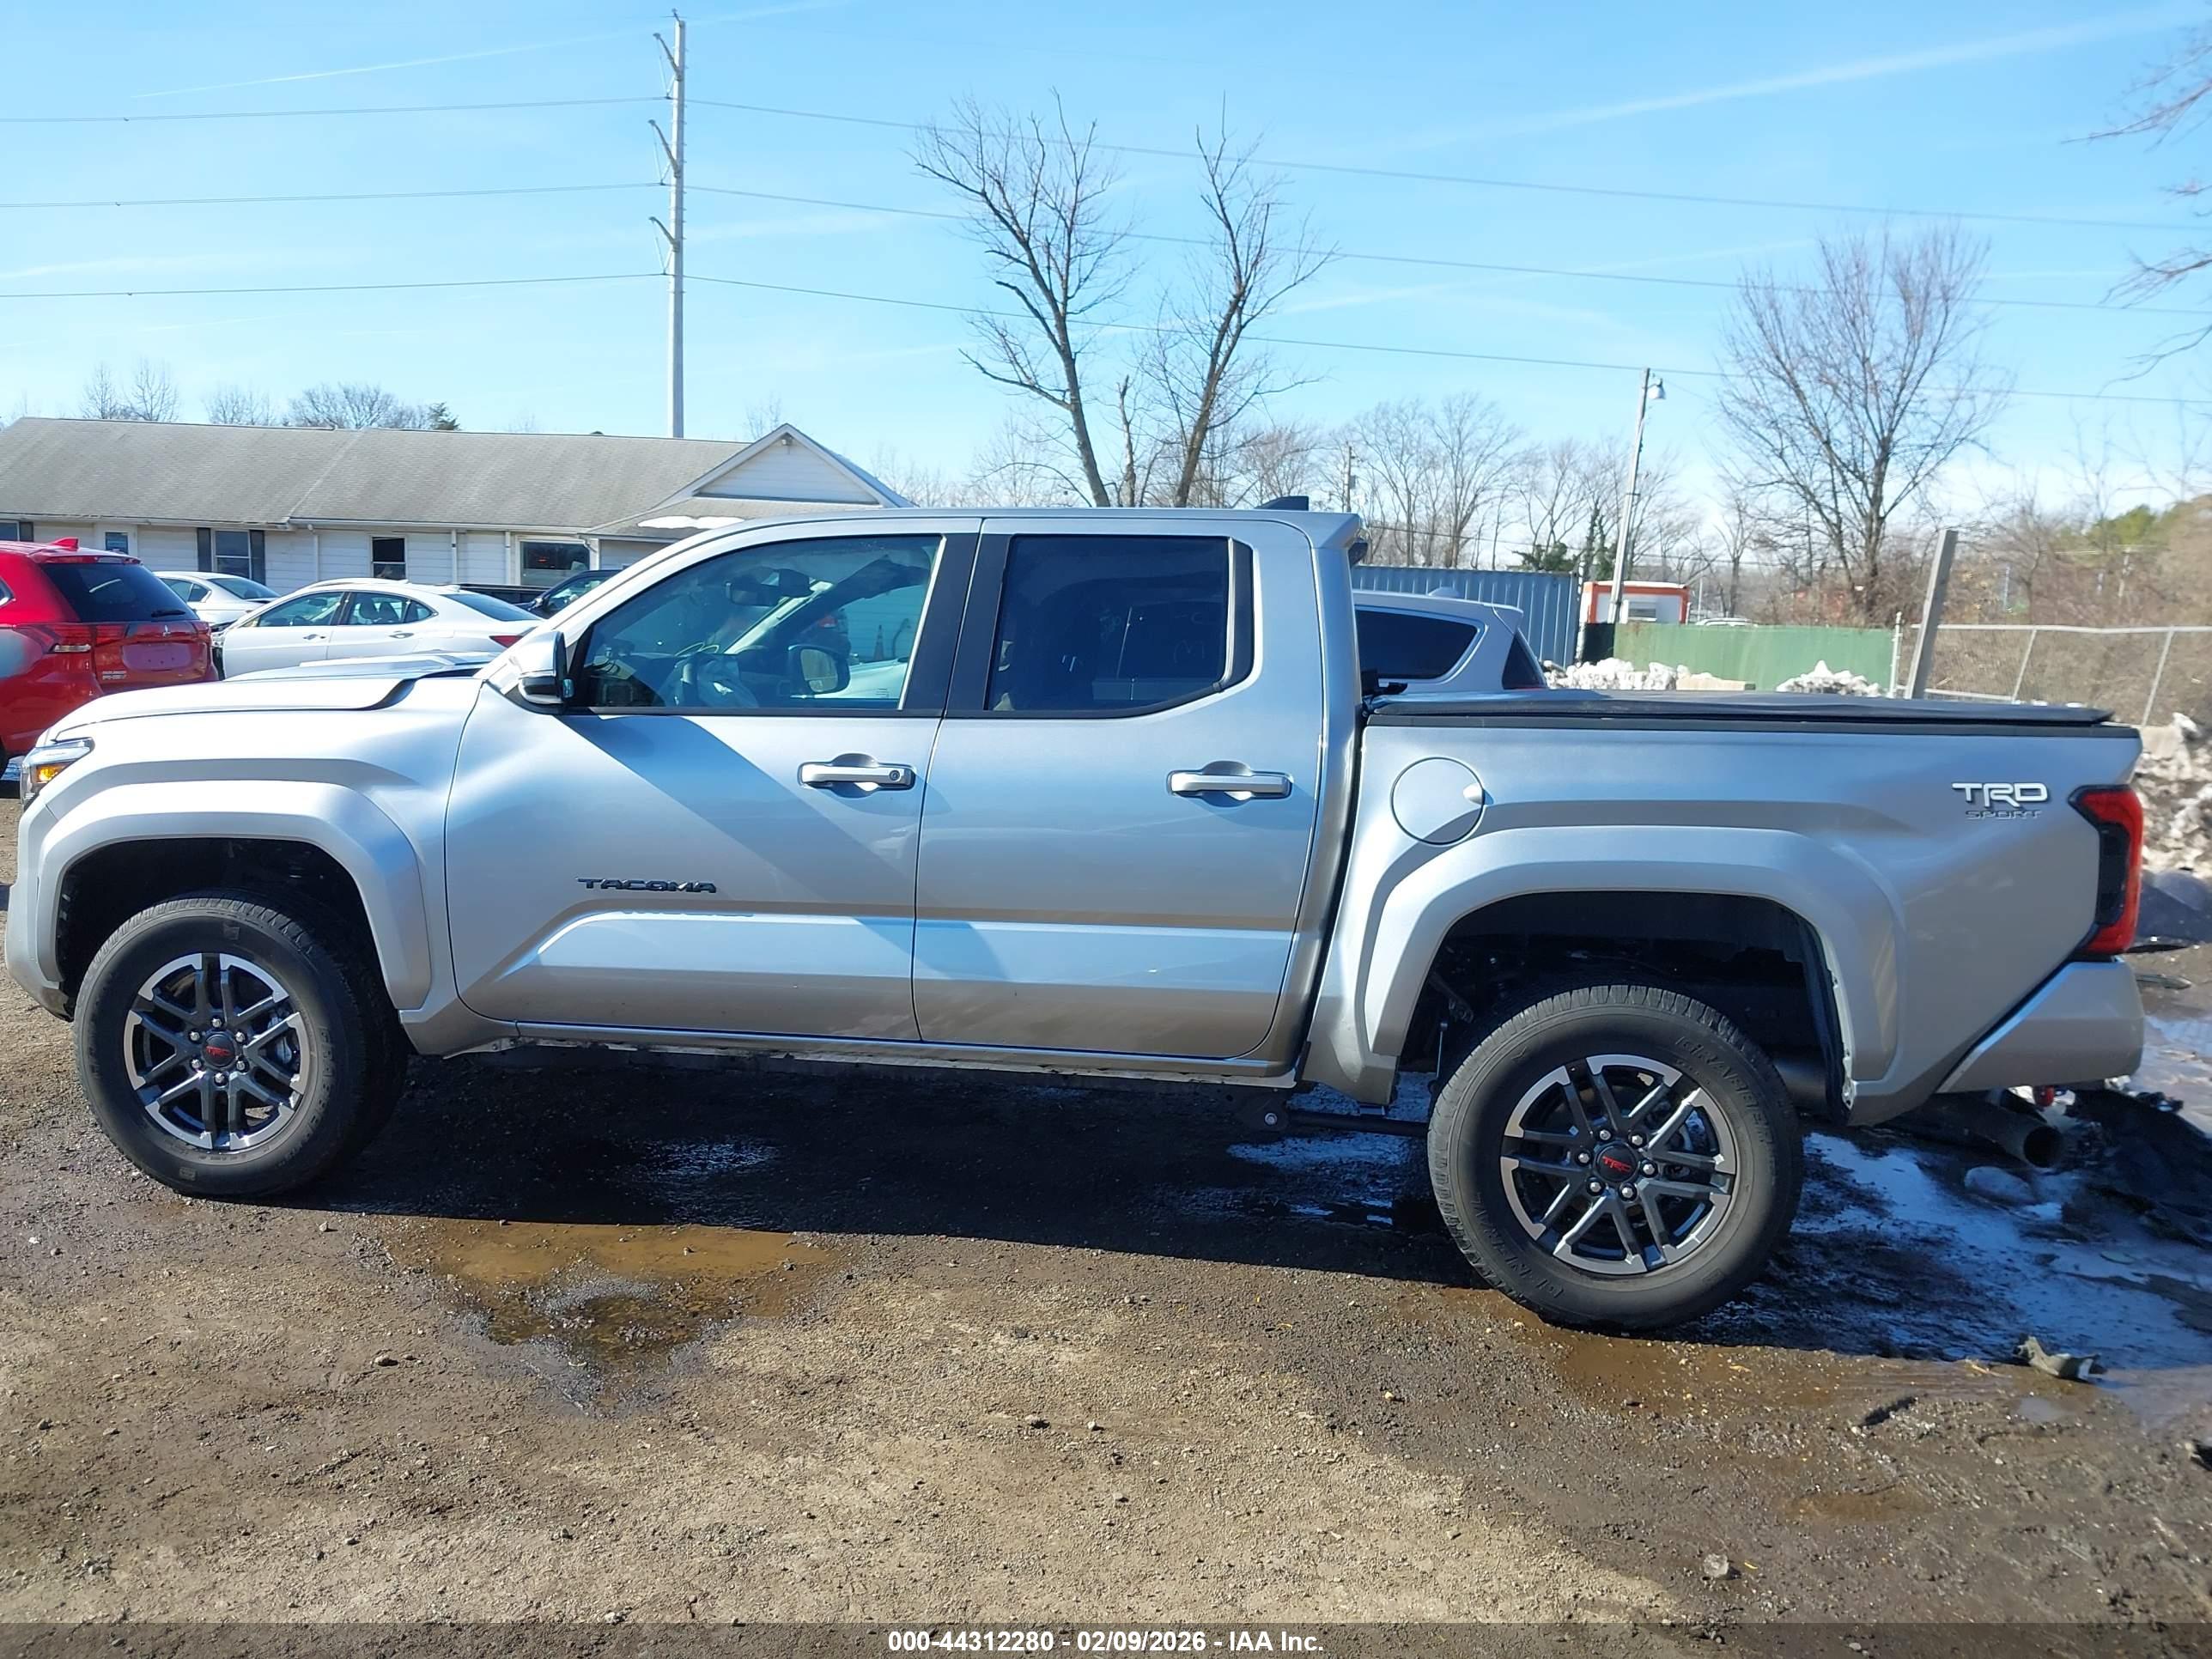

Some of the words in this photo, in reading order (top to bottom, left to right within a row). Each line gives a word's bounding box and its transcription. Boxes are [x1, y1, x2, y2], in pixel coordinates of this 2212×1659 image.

[1951, 781, 2048, 808] TRD
[1965, 809, 2043, 820] SPORT
[575, 877, 717, 893] TACOMA
